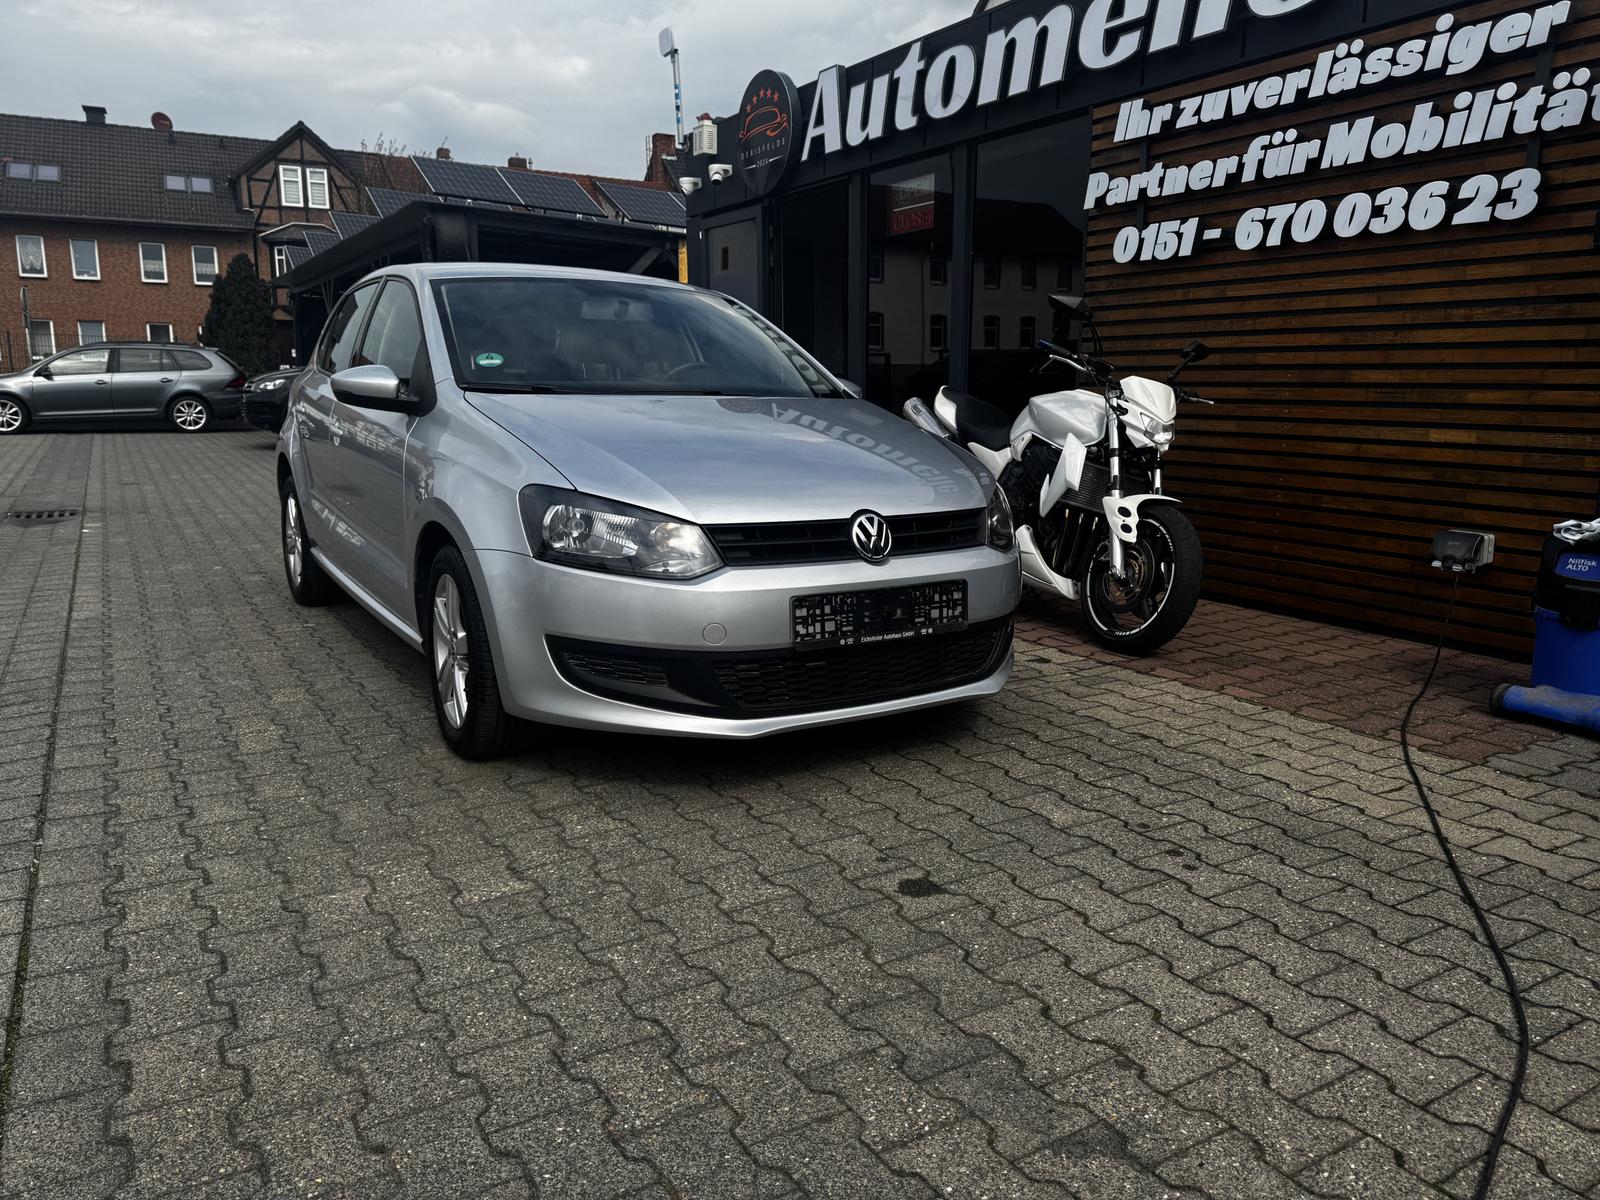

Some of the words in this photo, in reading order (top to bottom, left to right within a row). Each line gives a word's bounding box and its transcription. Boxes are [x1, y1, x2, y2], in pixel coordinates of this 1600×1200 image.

[801, 0, 1314, 161] Autome
[1113, 97, 1174, 143] Ihr
[1175, 0, 1571, 129] zuverlässiger
[1083, 156, 1240, 210] Partner
[1241, 128, 1322, 183] für
[1112, 216, 1199, 264] 0151
[1234, 199, 1328, 251] 670
[1333, 180, 1450, 238] 036
[1451, 167, 1541, 225] 23
[1566, 563, 1589, 572] ALTO
[1568, 558, 1597, 566] Nilfisk
